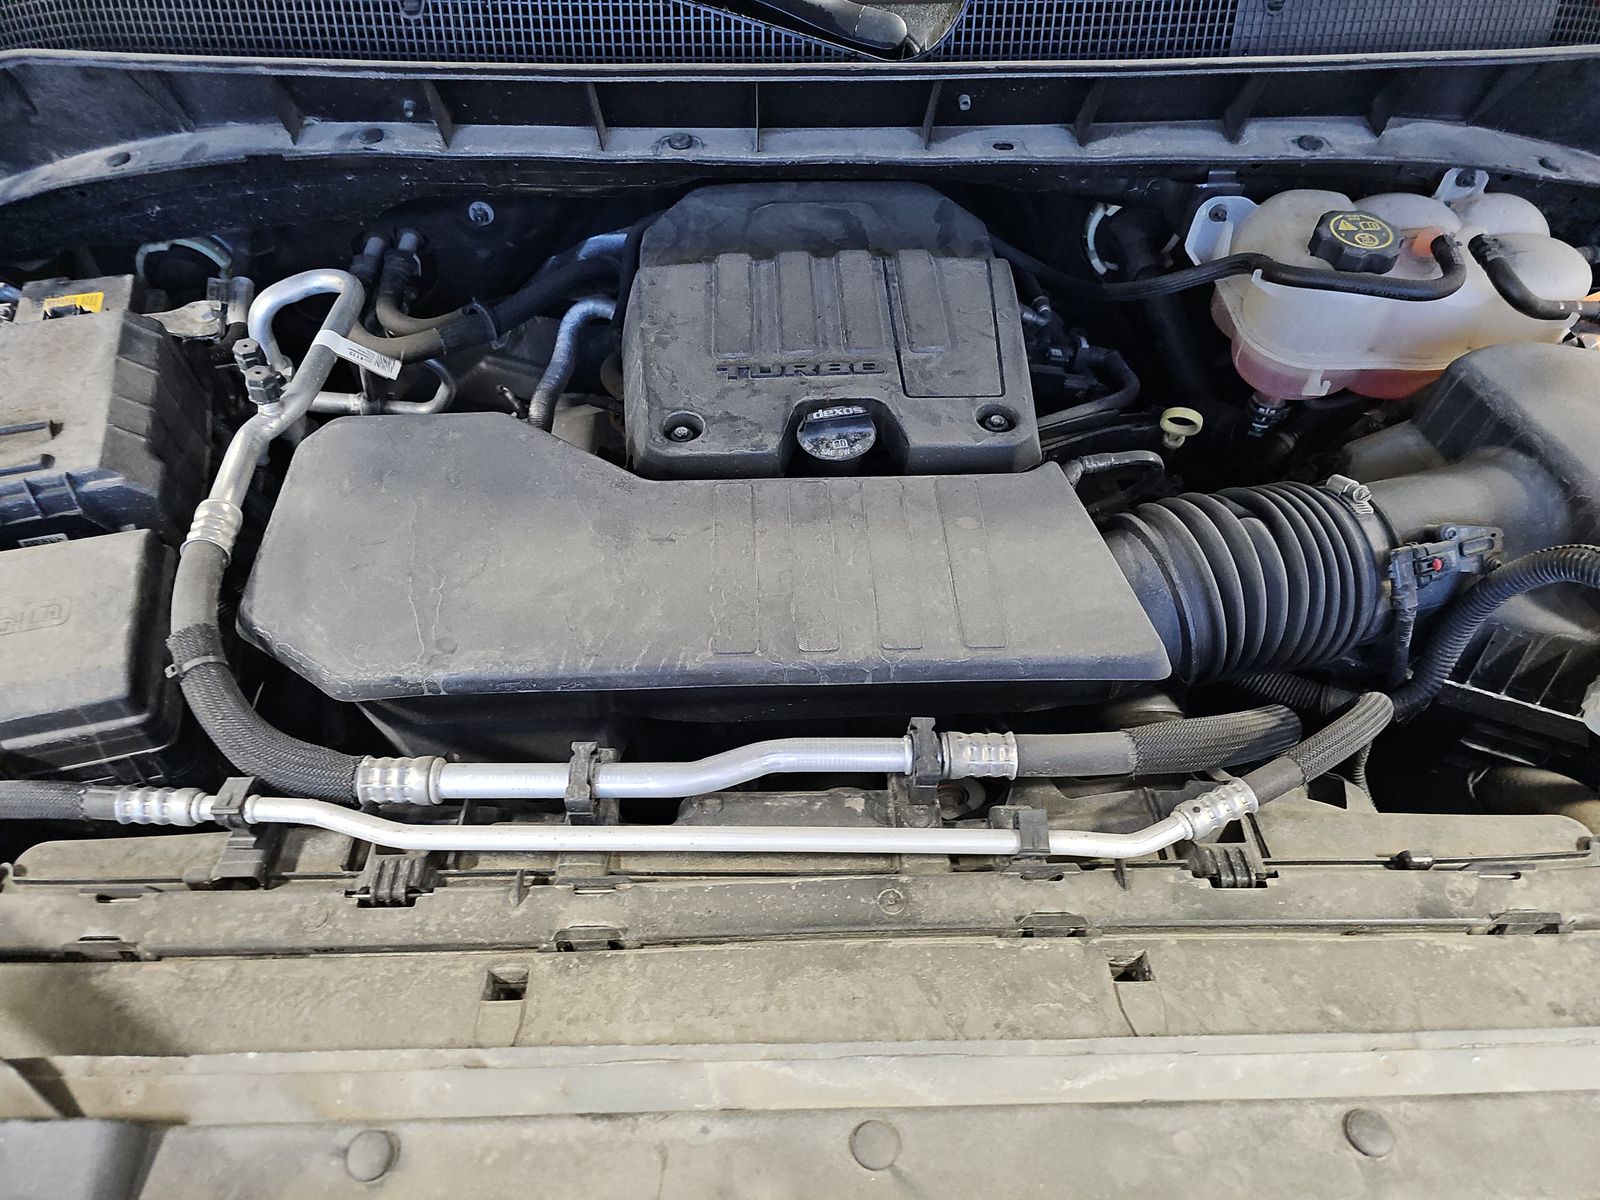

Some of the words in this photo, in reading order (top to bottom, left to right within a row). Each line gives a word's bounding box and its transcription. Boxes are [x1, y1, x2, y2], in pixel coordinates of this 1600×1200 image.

[716, 361, 886, 380] TURBO
[813, 406, 864, 419] dexos
[821, 448, 834, 456] SAE
[838, 444, 862, 456] 5W-30
